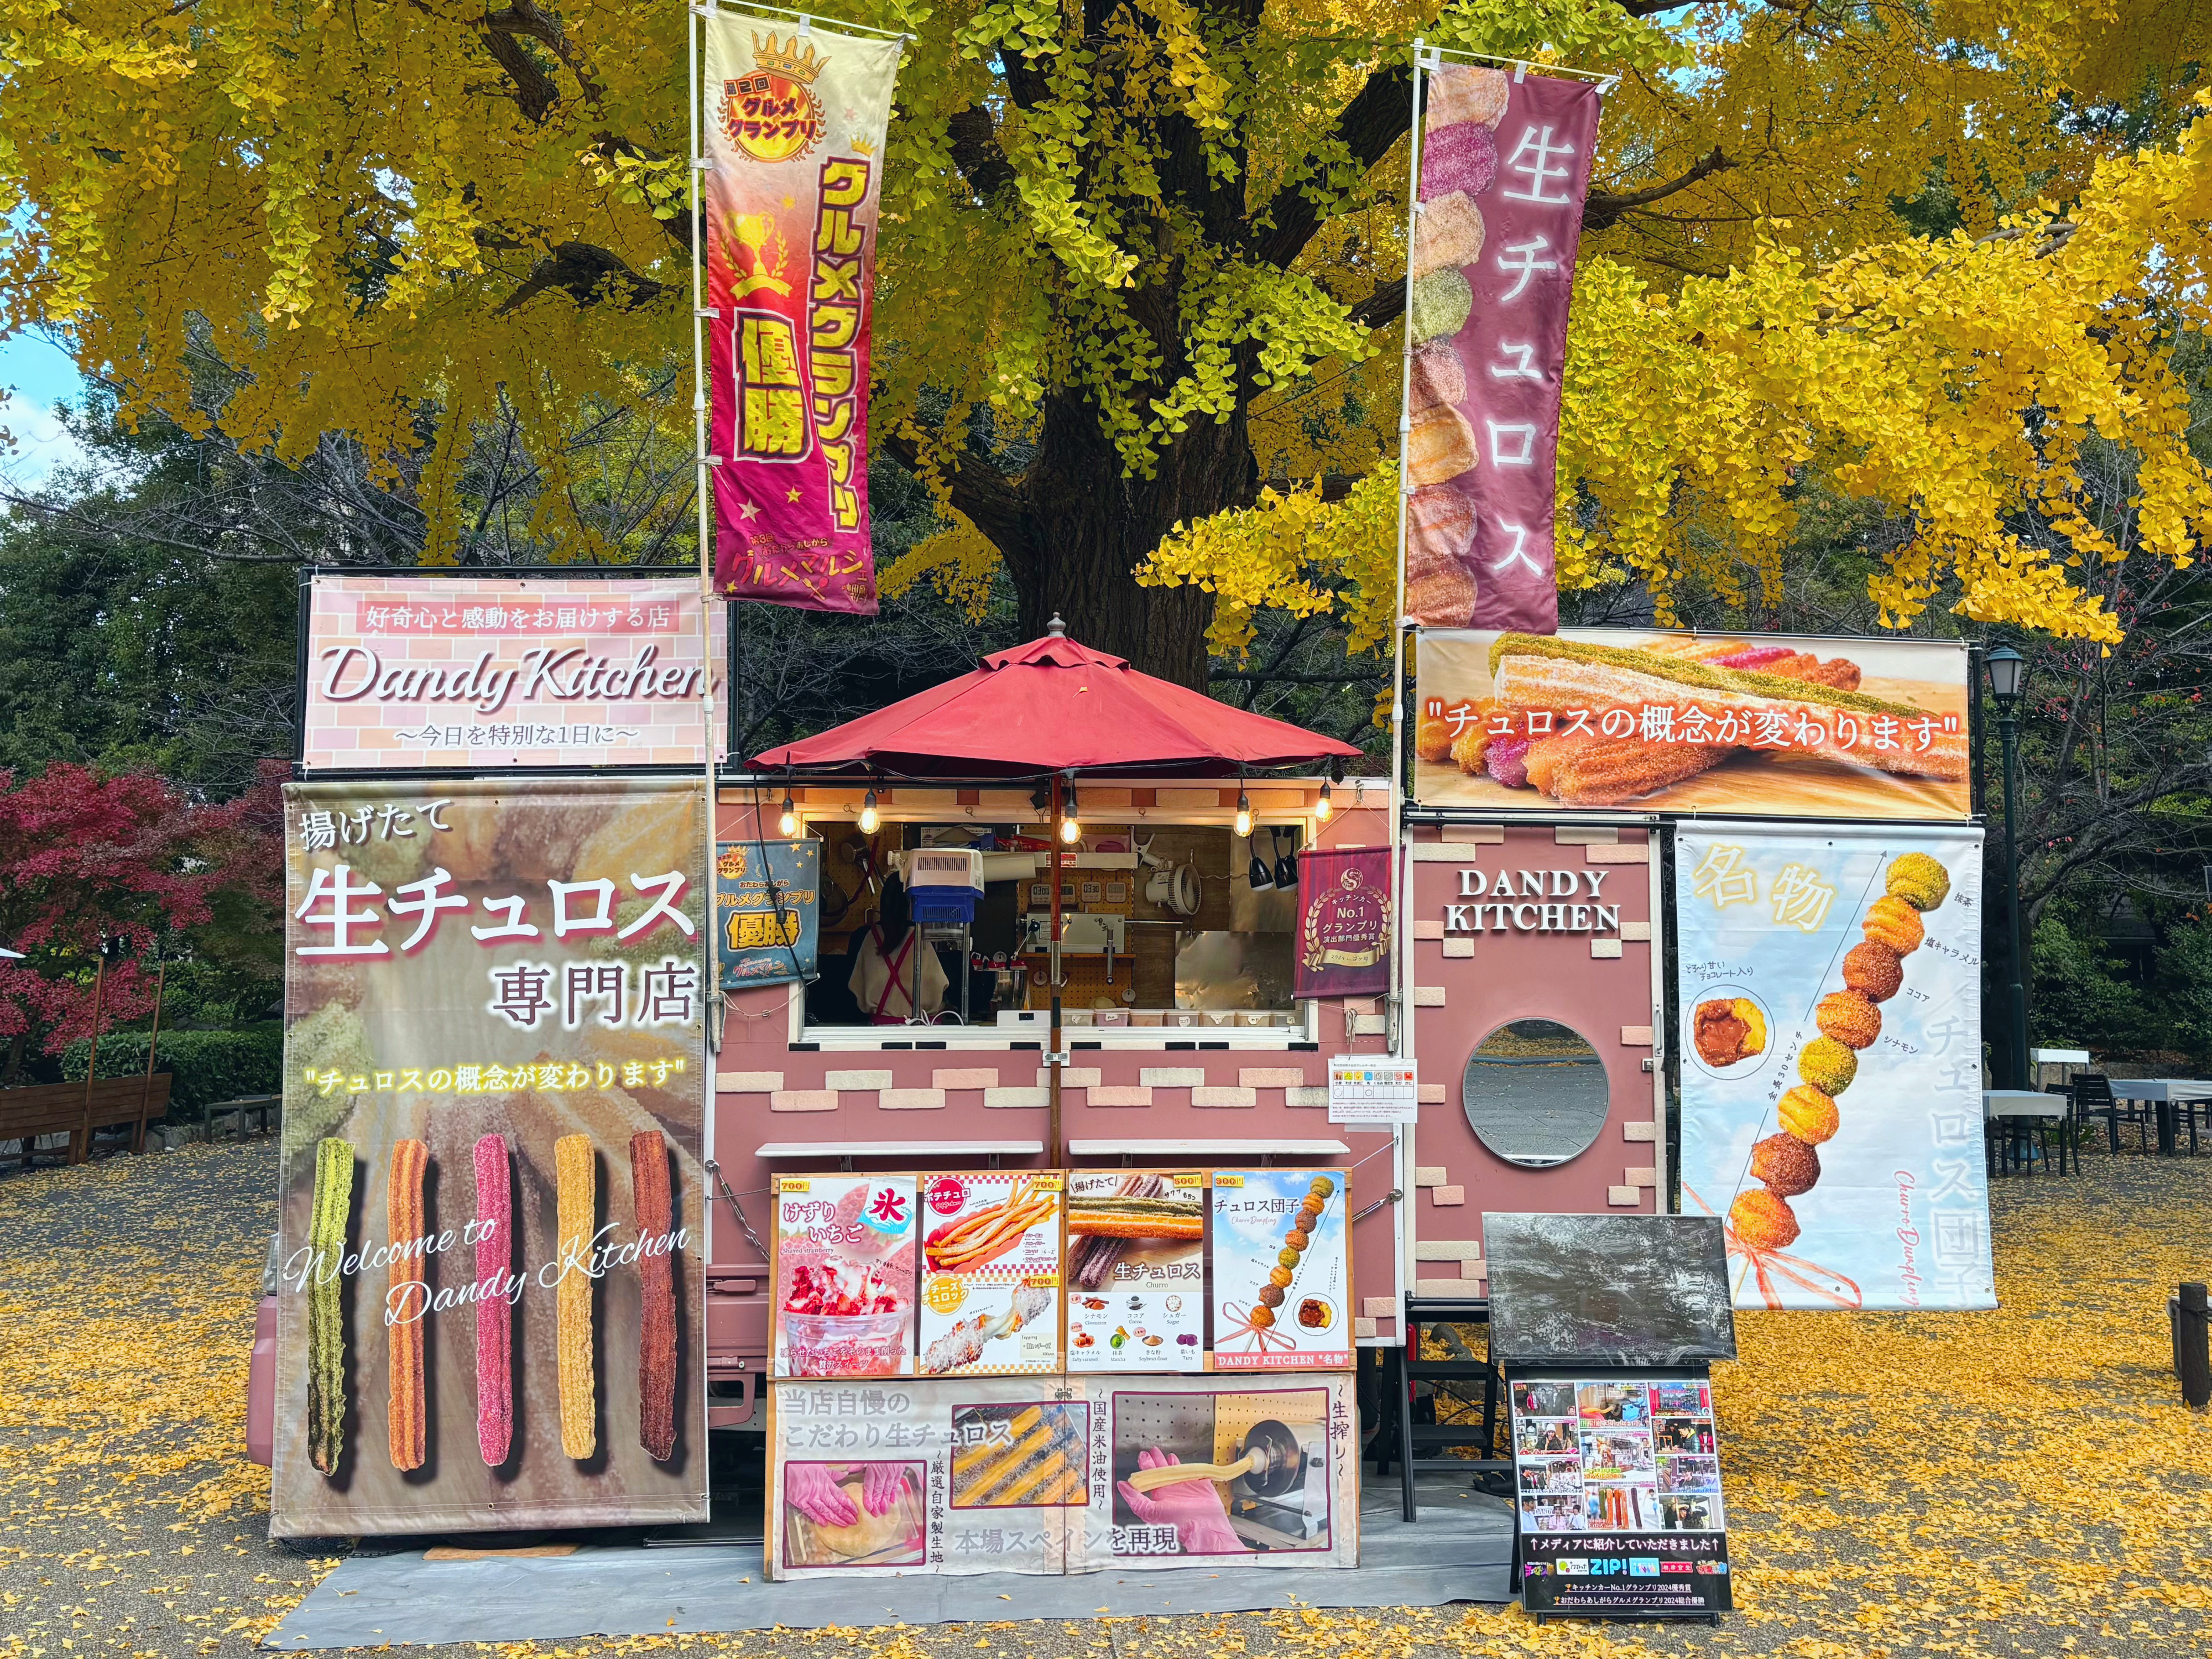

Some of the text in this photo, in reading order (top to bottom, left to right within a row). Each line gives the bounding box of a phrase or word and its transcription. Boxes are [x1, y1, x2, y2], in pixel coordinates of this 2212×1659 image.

[742, 96, 799, 118] グルメ
[726, 118, 817, 140] グランプリ
[1486, 125, 1575, 576] 生チュロス
[738, 311, 811, 459] 優勝
[366, 605, 670, 629] 好奇心と感動をお届けする店
[319, 644, 714, 712] Dandy Kitchen
[1428, 701, 1957, 752] "チュロスの概念が変わります"
[299, 798, 452, 851] 揚げたて
[1458, 869, 1609, 898] DANDY
[1694, 844, 1835, 931] 名物
[295, 864, 695, 957] 生チュロス
[1332, 894, 1371, 905] キッチンカー
[1337, 906, 1364, 918] No.1
[1953, 893, 1973, 907] 抹茶
[727, 910, 800, 950] 優勝
[1323, 920, 1377, 933] グランプリ
[1444, 903, 1621, 931] KITCHEN
[1924, 936, 1980, 966] 塩キャラメル
[1700, 967, 1753, 981] チョコレート入り
[493, 962, 696, 1026] 専門店
[1907, 987, 1931, 1003] ココア
[1884, 1034, 1919, 1055] シナモン
[305, 1058, 685, 1095] "チュロスの概念が変わります"
[1768, 1031, 1802, 1101] 全長30センチ
[1927, 1015, 1979, 1308] チュロス団子
[924, 1188, 971, 1202] ポテチュロ
[1075, 1176, 1114, 1192] 揚げたて
[783, 1202, 836, 1223] けずり
[869, 1187, 906, 1222] 氷
[1214, 1198, 1300, 1214] チュロス団子
[808, 1224, 863, 1244] いちご
[1894, 1170, 1920, 1310] Churro Dumpling
[283, 1217, 499, 1292] Welcome to
[384, 1221, 692, 1327] Dandy Kitchen
[1031, 1277, 1058, 1285] 700円
[1114, 1262, 1199, 1280] 生チュロス
[922, 1288, 969, 1305] チュロック
[931, 1282, 958, 1293] チーズ
[1218, 1356, 1259, 1366] DANDY
[1262, 1355, 1314, 1365] KITCHEN
[784, 1389, 910, 1416] 当店自慢の
[785, 1422, 1014, 1448] こだわり生チュロス
[954, 1525, 1177, 1554] 本場スペインを再現
[1590, 1558, 1627, 1575] ZIP!
